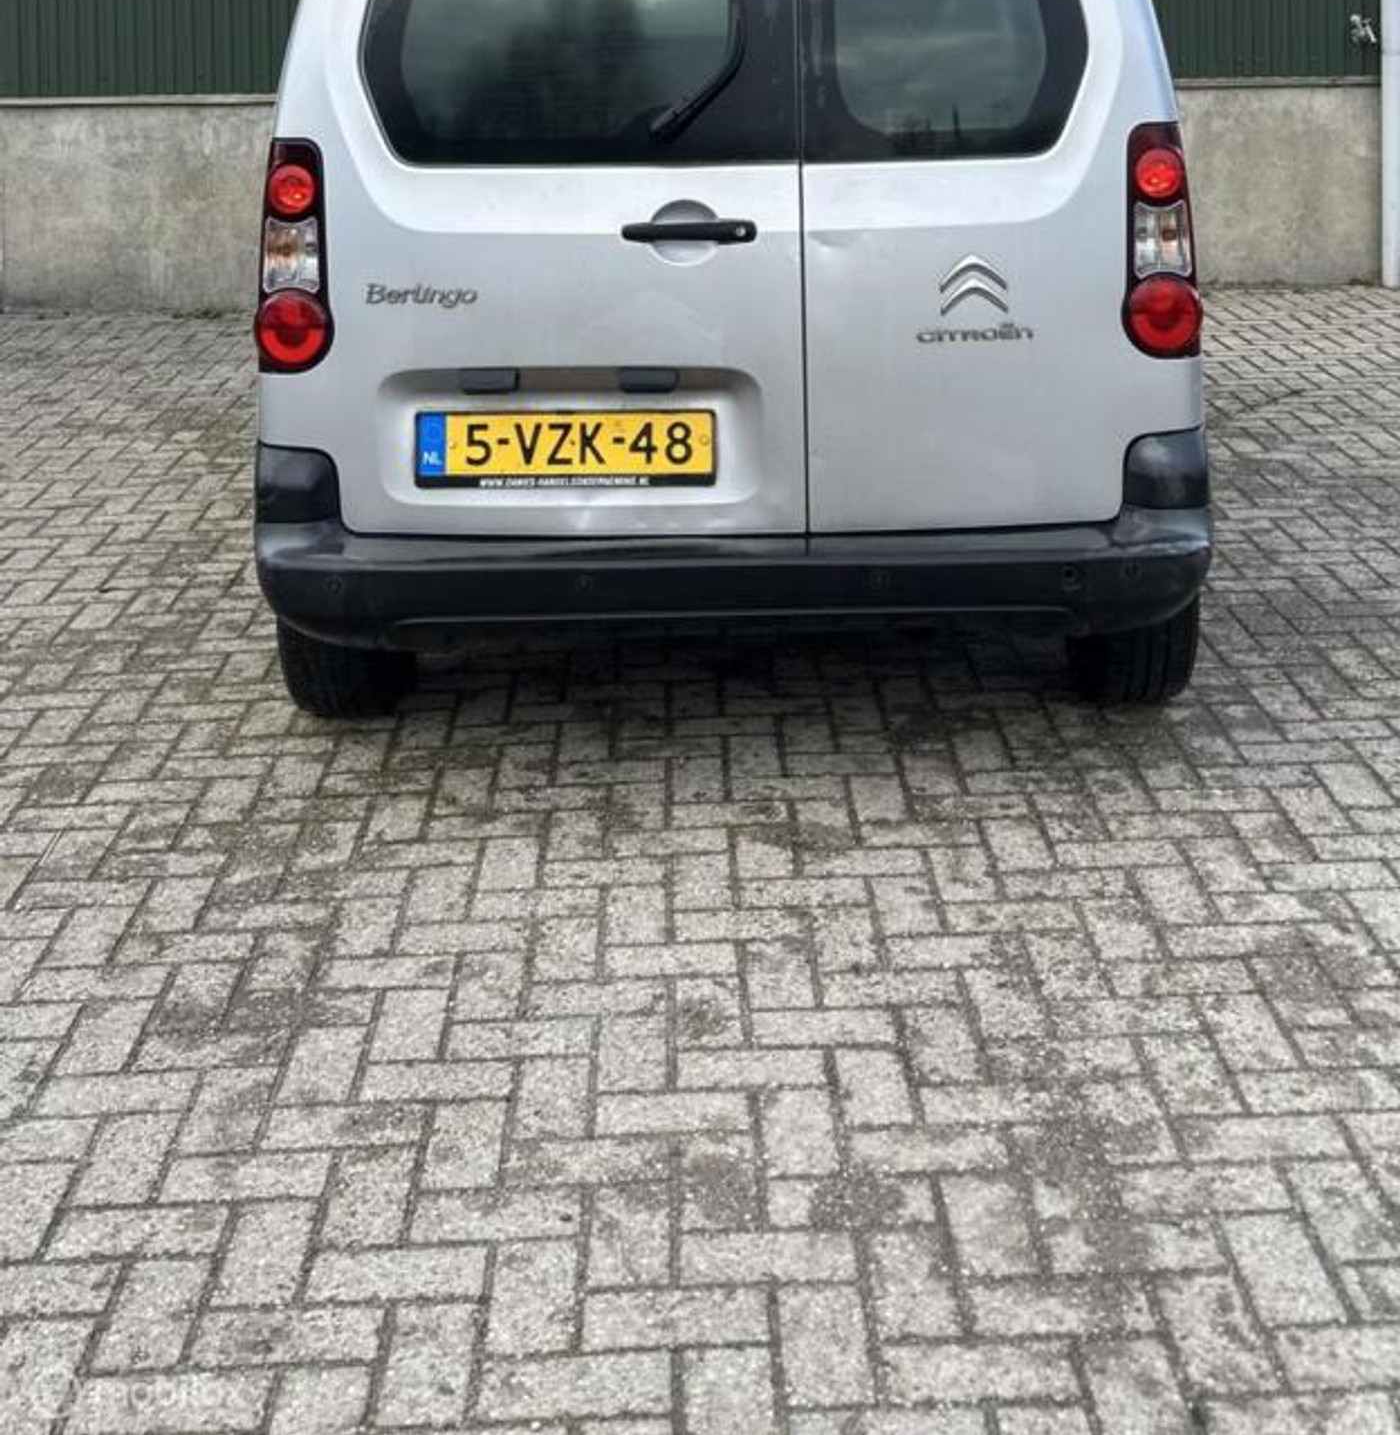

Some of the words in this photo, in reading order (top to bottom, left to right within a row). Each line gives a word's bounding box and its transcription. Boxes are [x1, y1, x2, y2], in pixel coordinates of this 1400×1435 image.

[365, 282, 478, 308] Berlingo
[465, 421, 693, 466] 5-VZK-48
[422, 451, 442, 465] NL
